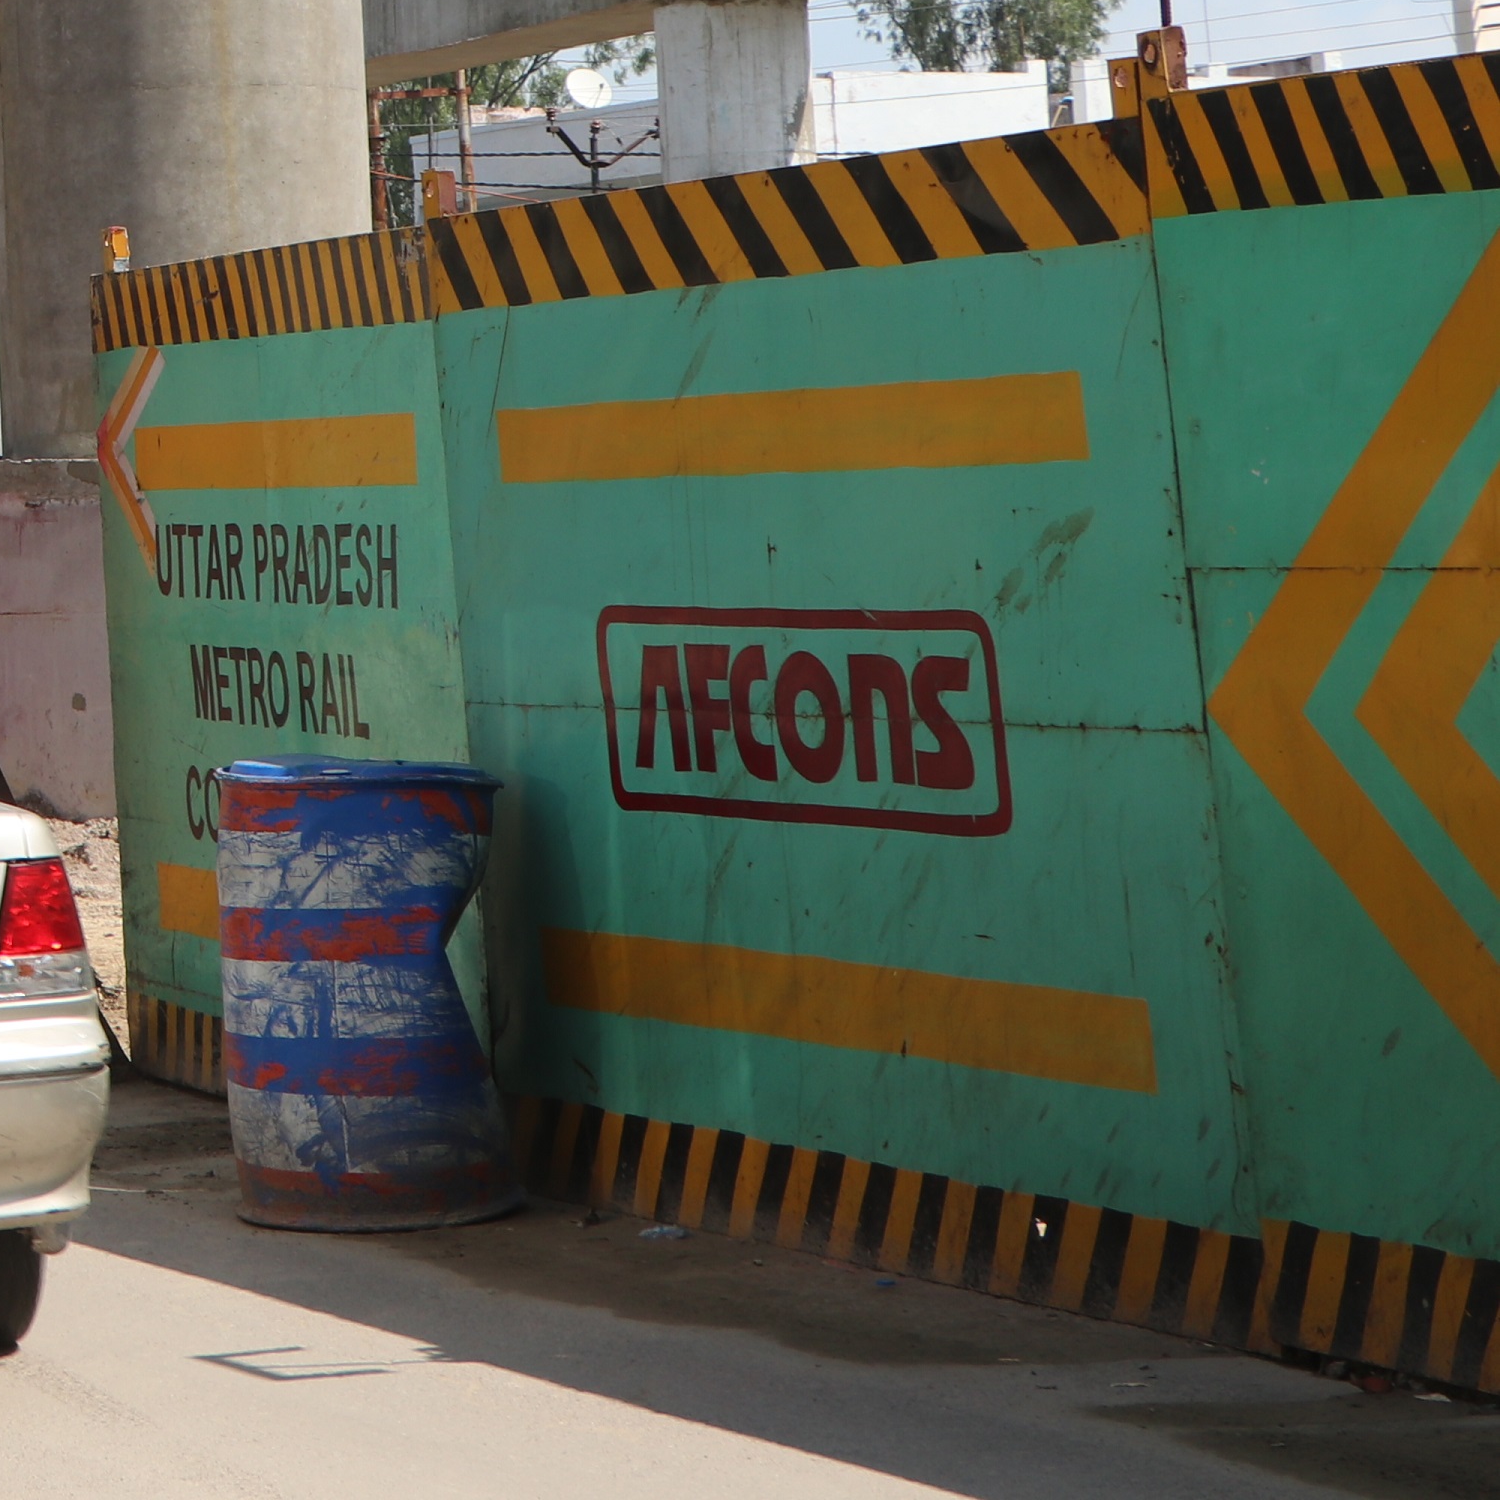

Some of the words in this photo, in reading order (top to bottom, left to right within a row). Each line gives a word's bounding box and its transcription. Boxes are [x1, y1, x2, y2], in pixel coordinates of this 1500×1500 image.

[155, 523, 246, 601] UTTAR
[253, 523, 398, 609] PRADESH
[189, 644, 290, 728] METRO
[296, 651, 370, 740] RAIL
[635, 643, 975, 790] AFCONS
